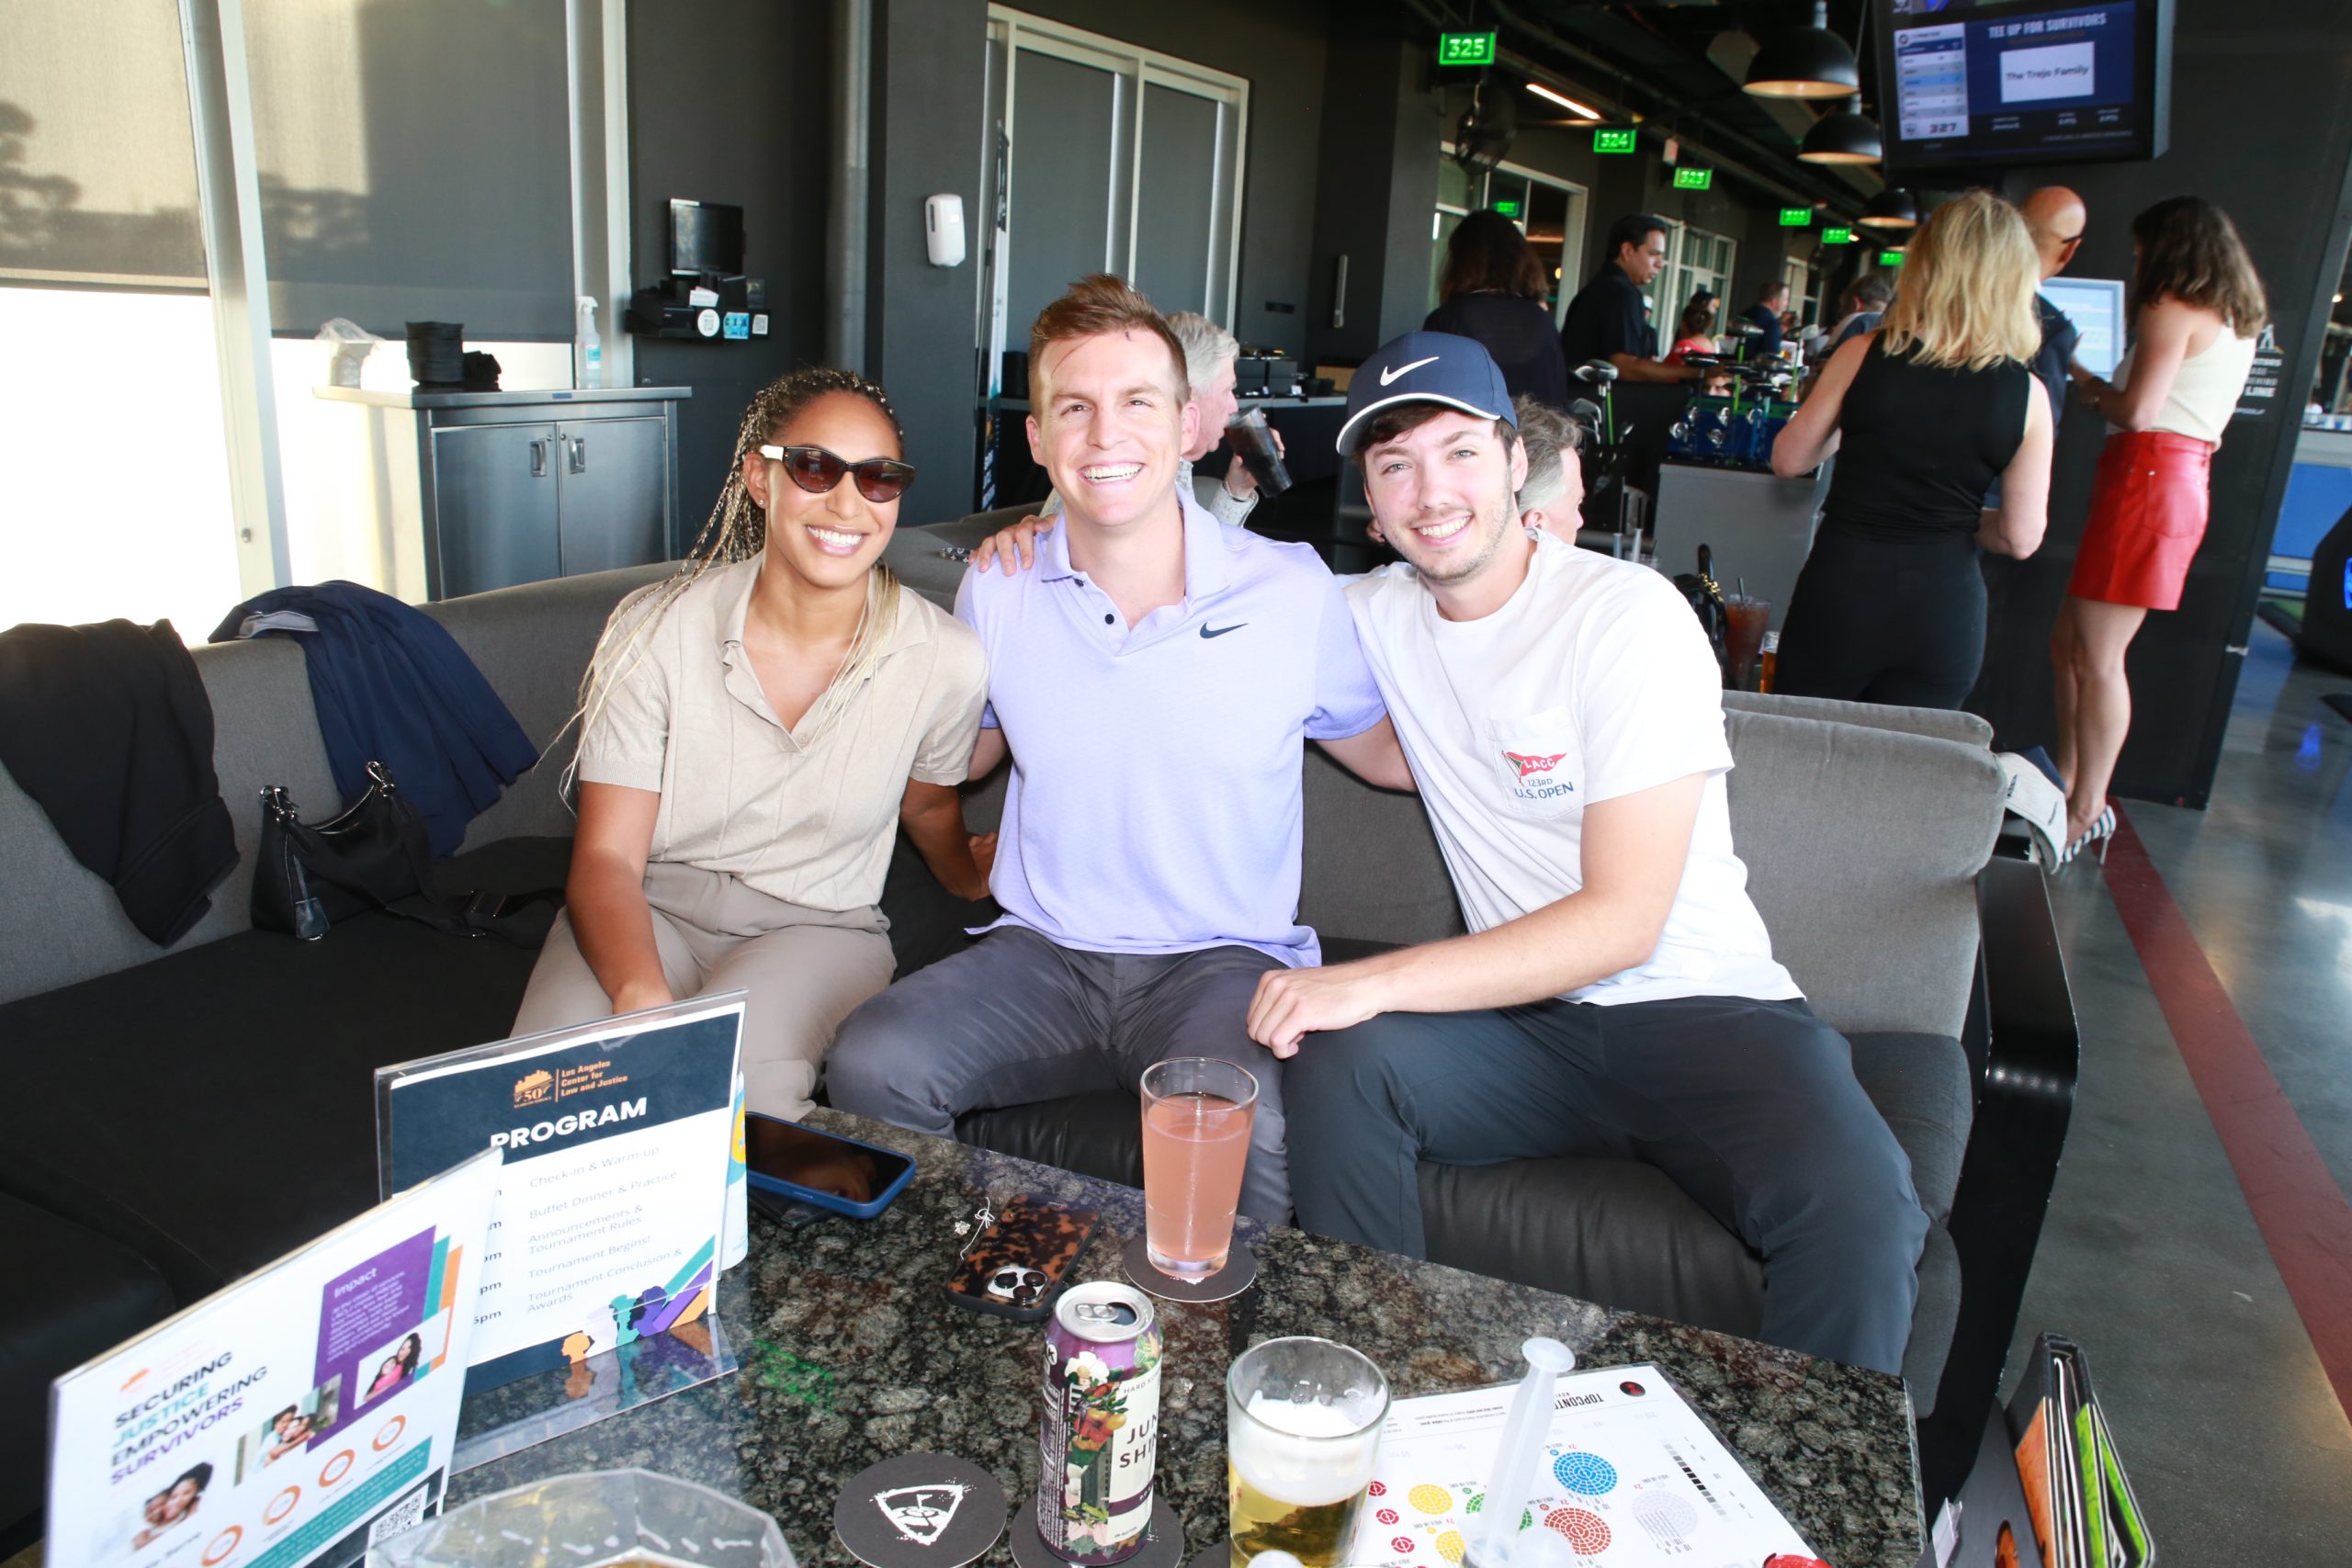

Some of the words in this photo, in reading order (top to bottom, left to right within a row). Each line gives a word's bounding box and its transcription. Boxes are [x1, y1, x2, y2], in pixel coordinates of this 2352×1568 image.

[1988, 25, 2005, 39] TEE
[2007, 23, 2021, 37] UP
[2023, 20, 2044, 35] FOR
[2045, 12, 2107, 32] SURVIVORS
[1448, 38, 1486, 58] 325
[2007, 72, 2024, 81] The
[2054, 64, 2089, 77] Family
[1929, 122, 1957, 134] 327
[1600, 133, 1628, 148] 324
[2245, 386, 2277, 398] LINE
[1523, 757, 1555, 770] LACC
[1514, 787, 1537, 799] U.S.
[1538, 781, 1574, 799] OPEN
[1527, 778, 1553, 787] 123RD
[561, 1067, 575, 1077] Los
[577, 1060, 611, 1074] Angeles
[561, 1075, 589, 1087] Center
[591, 1071, 604, 1080] for
[523, 1088, 543, 1100] 50
[561, 1087, 578, 1097] Law
[580, 1082, 595, 1092] and
[597, 1075, 628, 1088] Justice
[490, 1097, 648, 1148] PROGRAM
[529, 1167, 585, 1188] Check-in
[588, 1161, 597, 1171] &
[602, 1146, 660, 1168] Warm-up
[529, 1201, 568, 1220] Buffet
[572, 1189, 614, 1207] Dinner
[617, 1185, 627, 1193] &
[630, 1171, 678, 1190] Practice
[528, 1208, 630, 1244] Announcements
[634, 1204, 643, 1213] &
[529, 1225, 605, 1255] Tournament
[610, 1215, 641, 1232] Rules
[528, 1250, 605, 1279] Tournament
[608, 1235, 651, 1253] Begins!
[334, 1268, 377, 1299] Impact
[528, 1272, 603, 1302] Tournament
[606, 1253, 671, 1278] Conclusion
[673, 1247, 683, 1257] &
[527, 1292, 573, 1313] Awards
[115, 1351, 233, 1428] SECURING
[1124, 1382, 1146, 1393] HARD
[111, 1365, 268, 1468] EMPOWERING
[113, 1382, 210, 1449] JUSTICE
[111, 1396, 244, 1485] SURVIVORS
